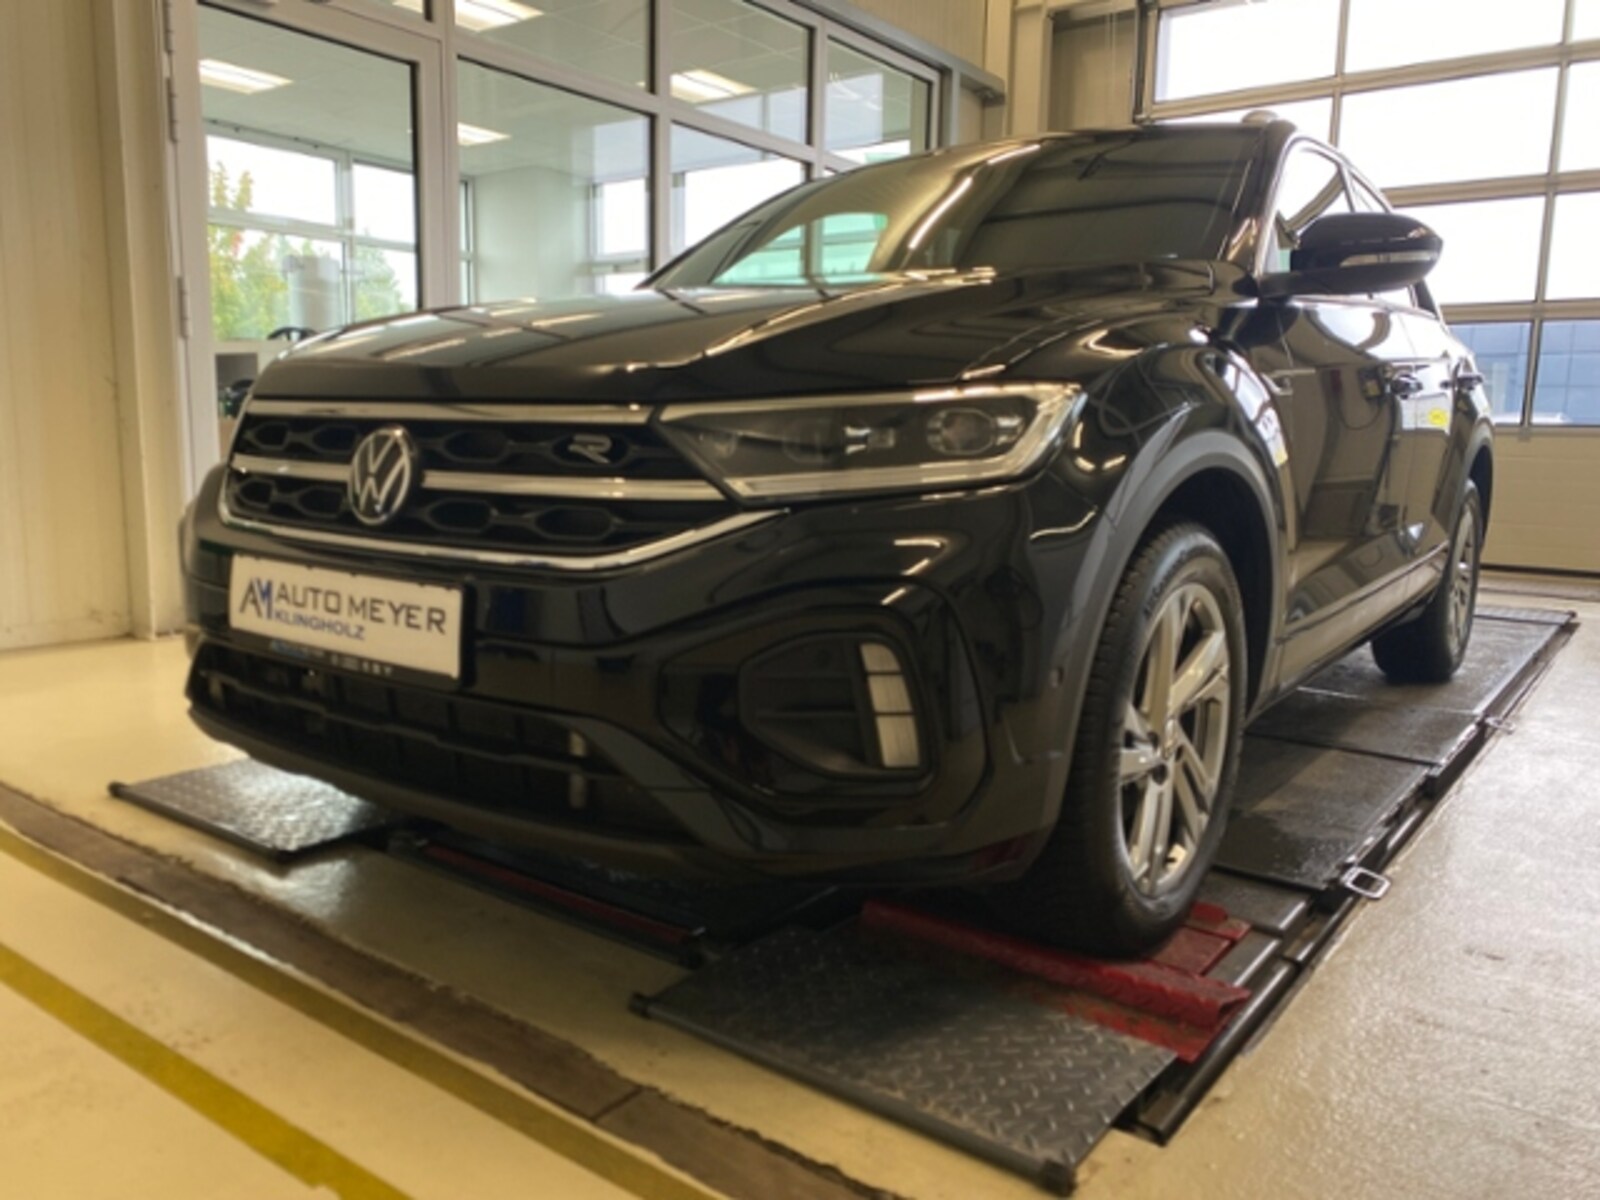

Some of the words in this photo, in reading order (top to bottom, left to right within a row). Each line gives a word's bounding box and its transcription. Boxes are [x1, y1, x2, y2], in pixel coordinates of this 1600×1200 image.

[275, 581, 342, 615] AUTO
[349, 596, 447, 635] MEYER
[275, 611, 366, 641] KLINGHOLZ
